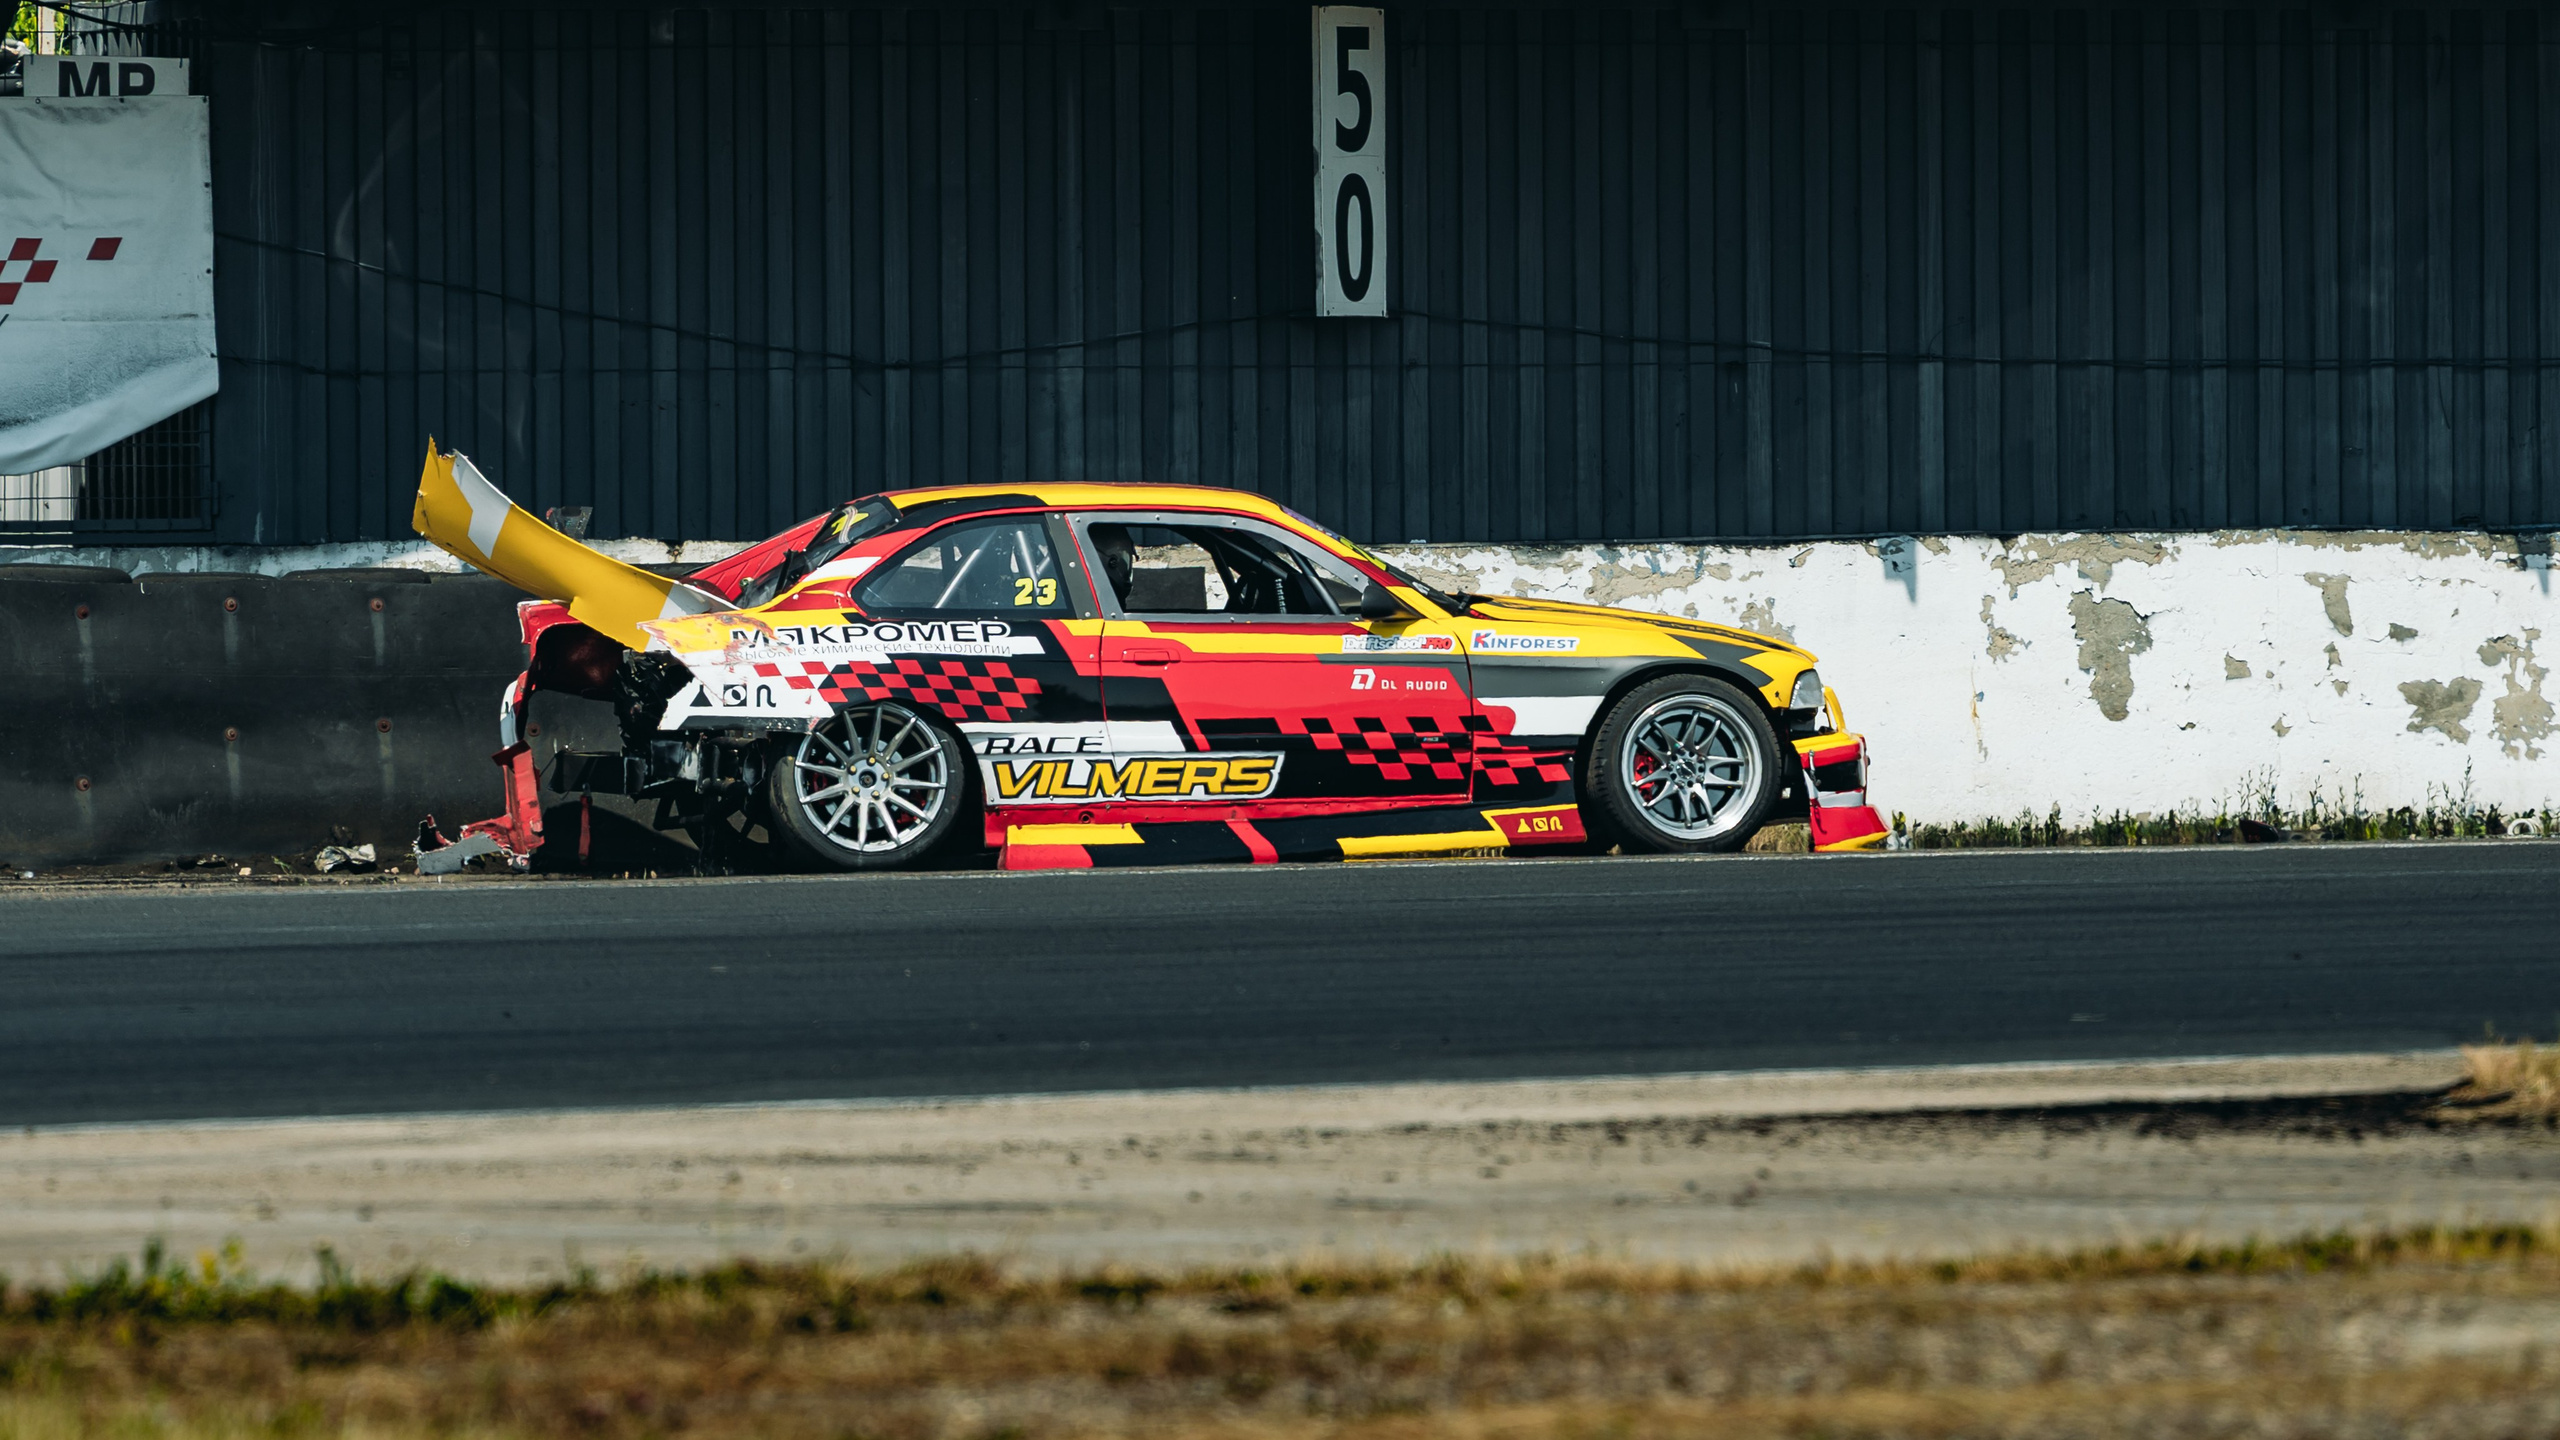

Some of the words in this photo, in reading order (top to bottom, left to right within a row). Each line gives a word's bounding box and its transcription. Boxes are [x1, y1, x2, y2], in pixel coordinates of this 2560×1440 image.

[1335, 26, 1374, 302] 50
[1013, 576, 1058, 607] 23
[811, 642, 912, 655] химические
[917, 643, 1012, 655] технологии
[1473, 632, 1577, 649] KINFOREST
[1381, 679, 1398, 690] DL
[1405, 680, 1448, 691] AUDIO
[984, 736, 1105, 755] RACE
[991, 756, 1279, 799] VILMERS
